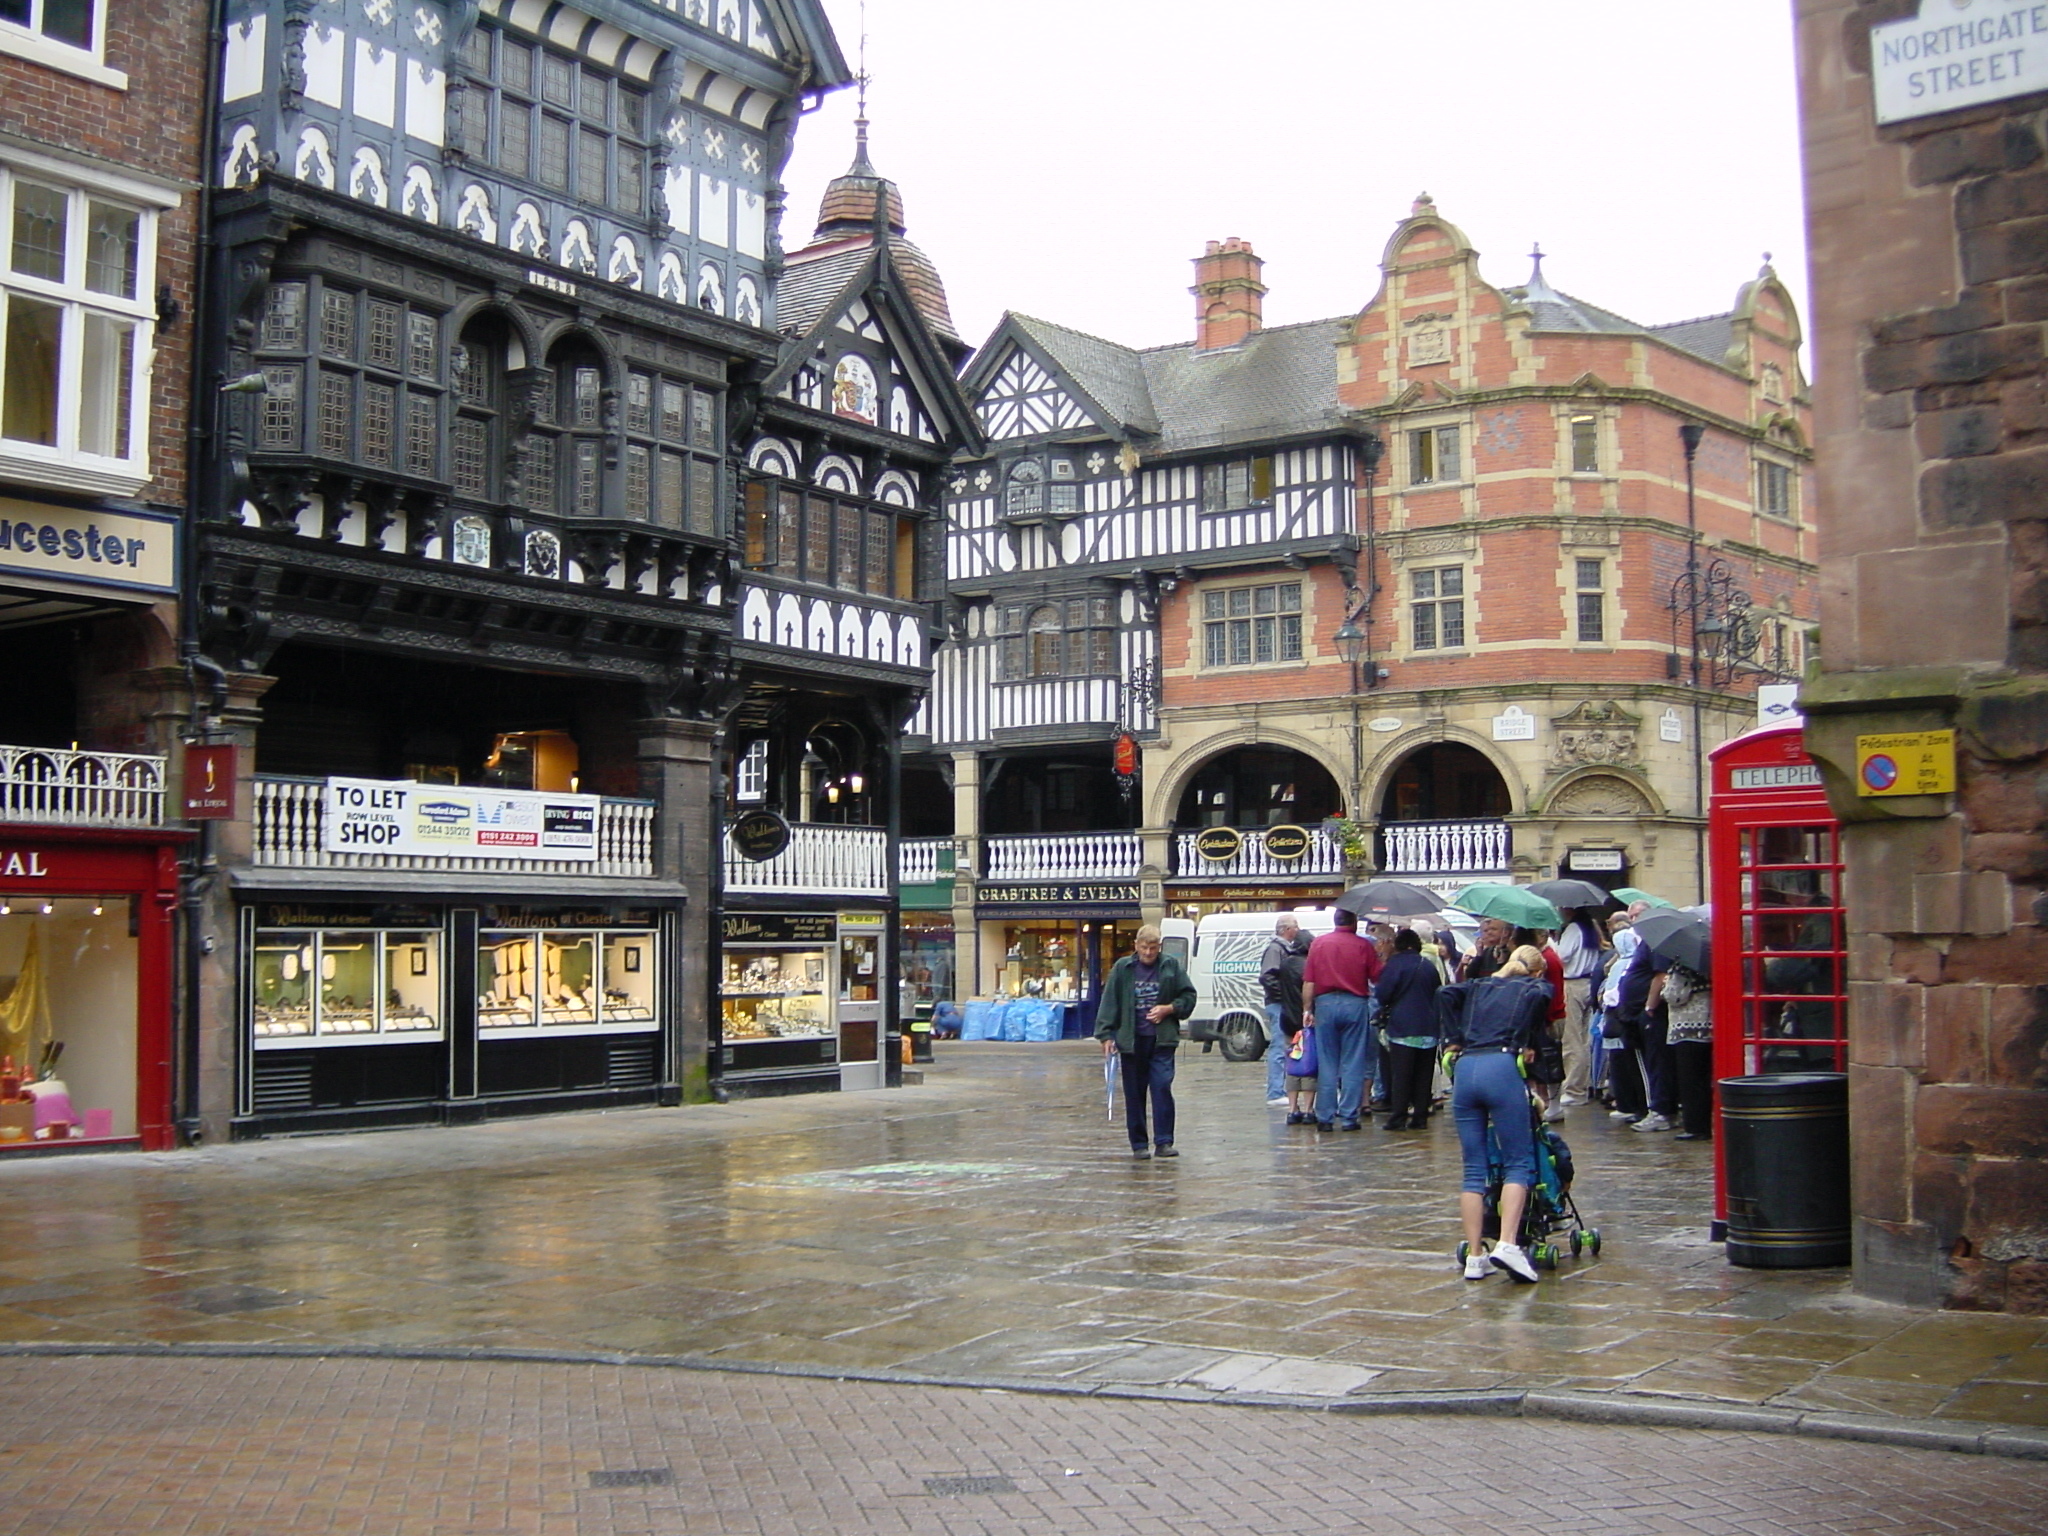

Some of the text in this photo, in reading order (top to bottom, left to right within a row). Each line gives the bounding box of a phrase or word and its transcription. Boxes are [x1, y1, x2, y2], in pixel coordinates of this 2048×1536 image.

[1882, 4, 2048, 67] NORTHGATE
[1907, 48, 2025, 98] STREET
[1860, 735, 1950, 749] Pedestrian Zone
[1919, 768, 1937, 778] any
[1917, 780, 1938, 790] time
[336, 786, 408, 810] TO LET
[346, 812, 396, 823] ROW LEVEL
[339, 822, 401, 846] SHOP
[0, 851, 48, 876] AL
[978, 886, 1140, 901] CRABTREE & EVELYN
[1214, 961, 1261, 973] HIGHWA
